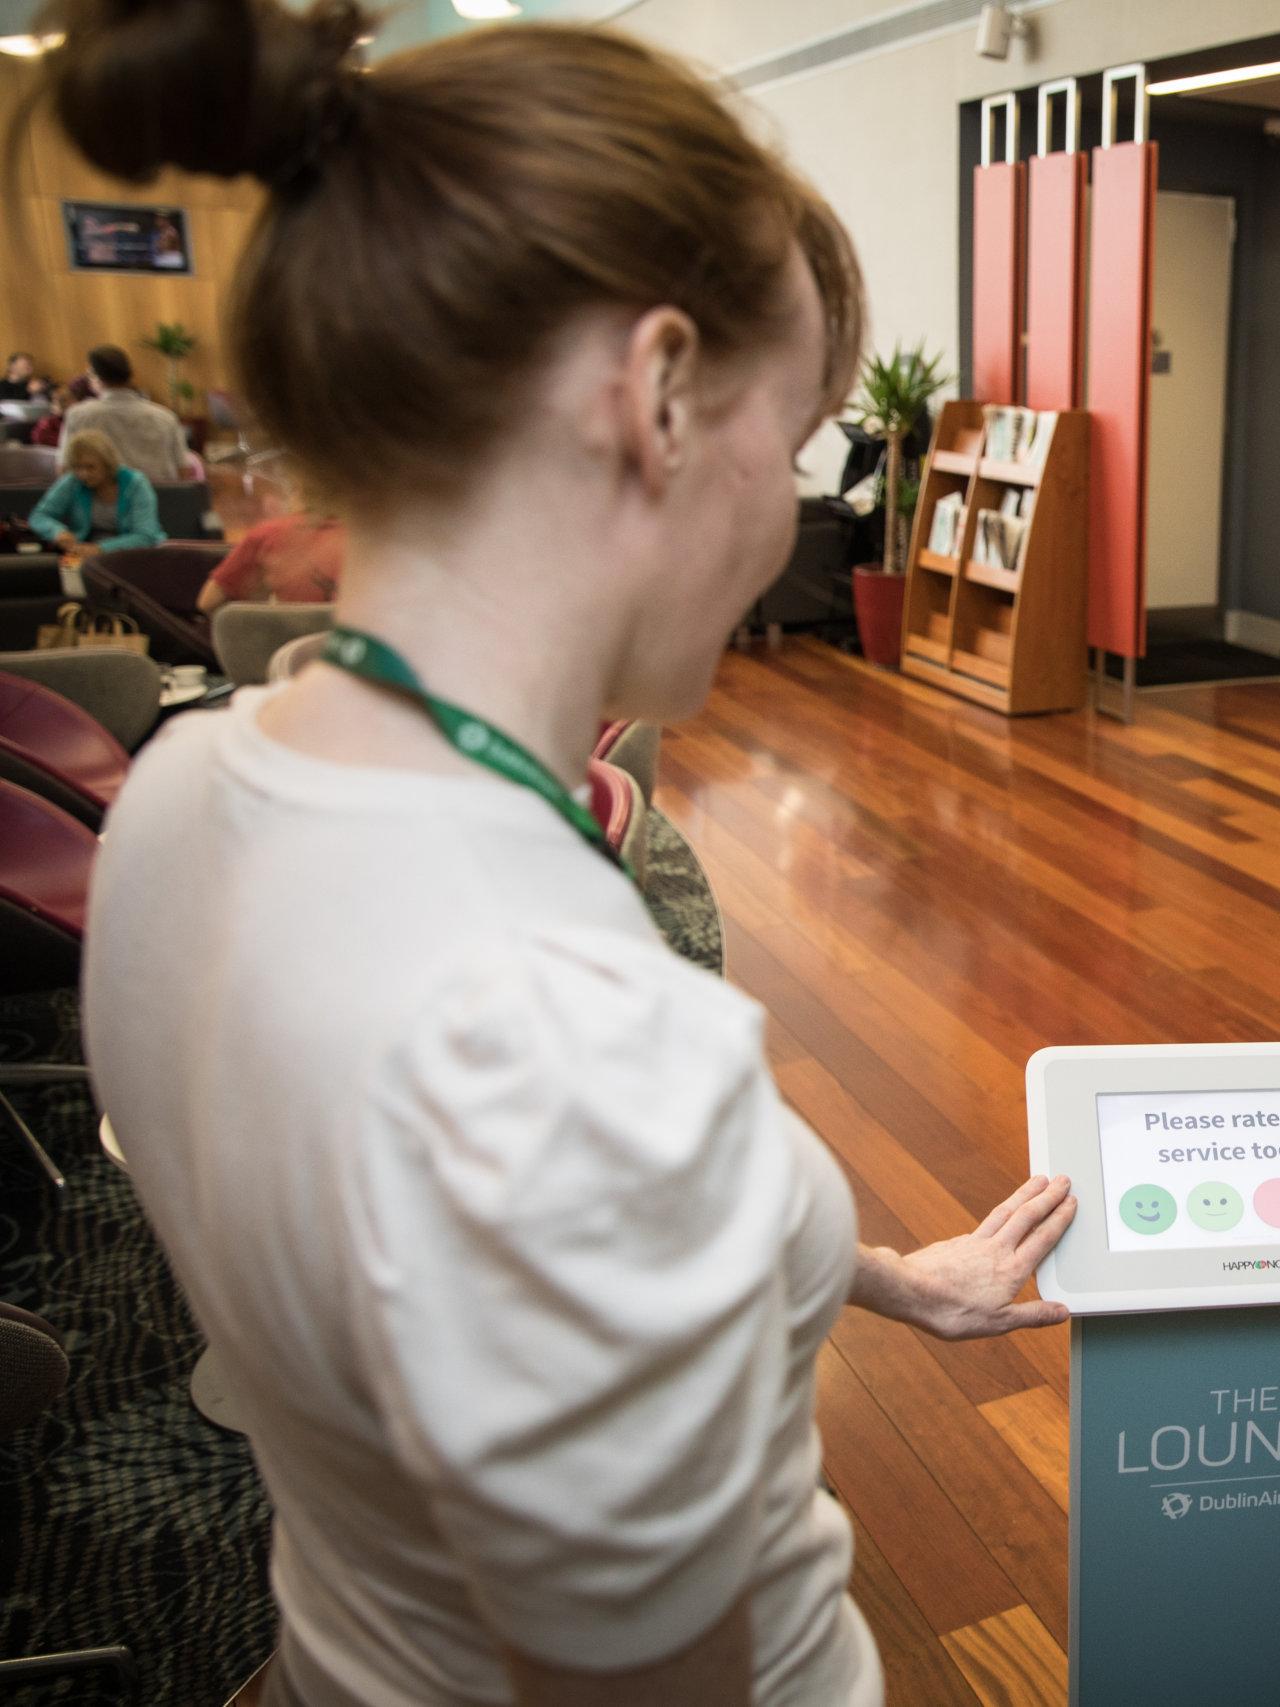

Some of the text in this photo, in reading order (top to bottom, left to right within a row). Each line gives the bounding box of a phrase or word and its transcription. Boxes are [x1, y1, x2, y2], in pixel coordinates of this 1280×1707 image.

[1145, 1111, 1225, 1131] Please
[1231, 1110, 1280, 1128] rate
[1158, 1142, 1246, 1163] service
[1210, 1386, 1279, 1415] THE
